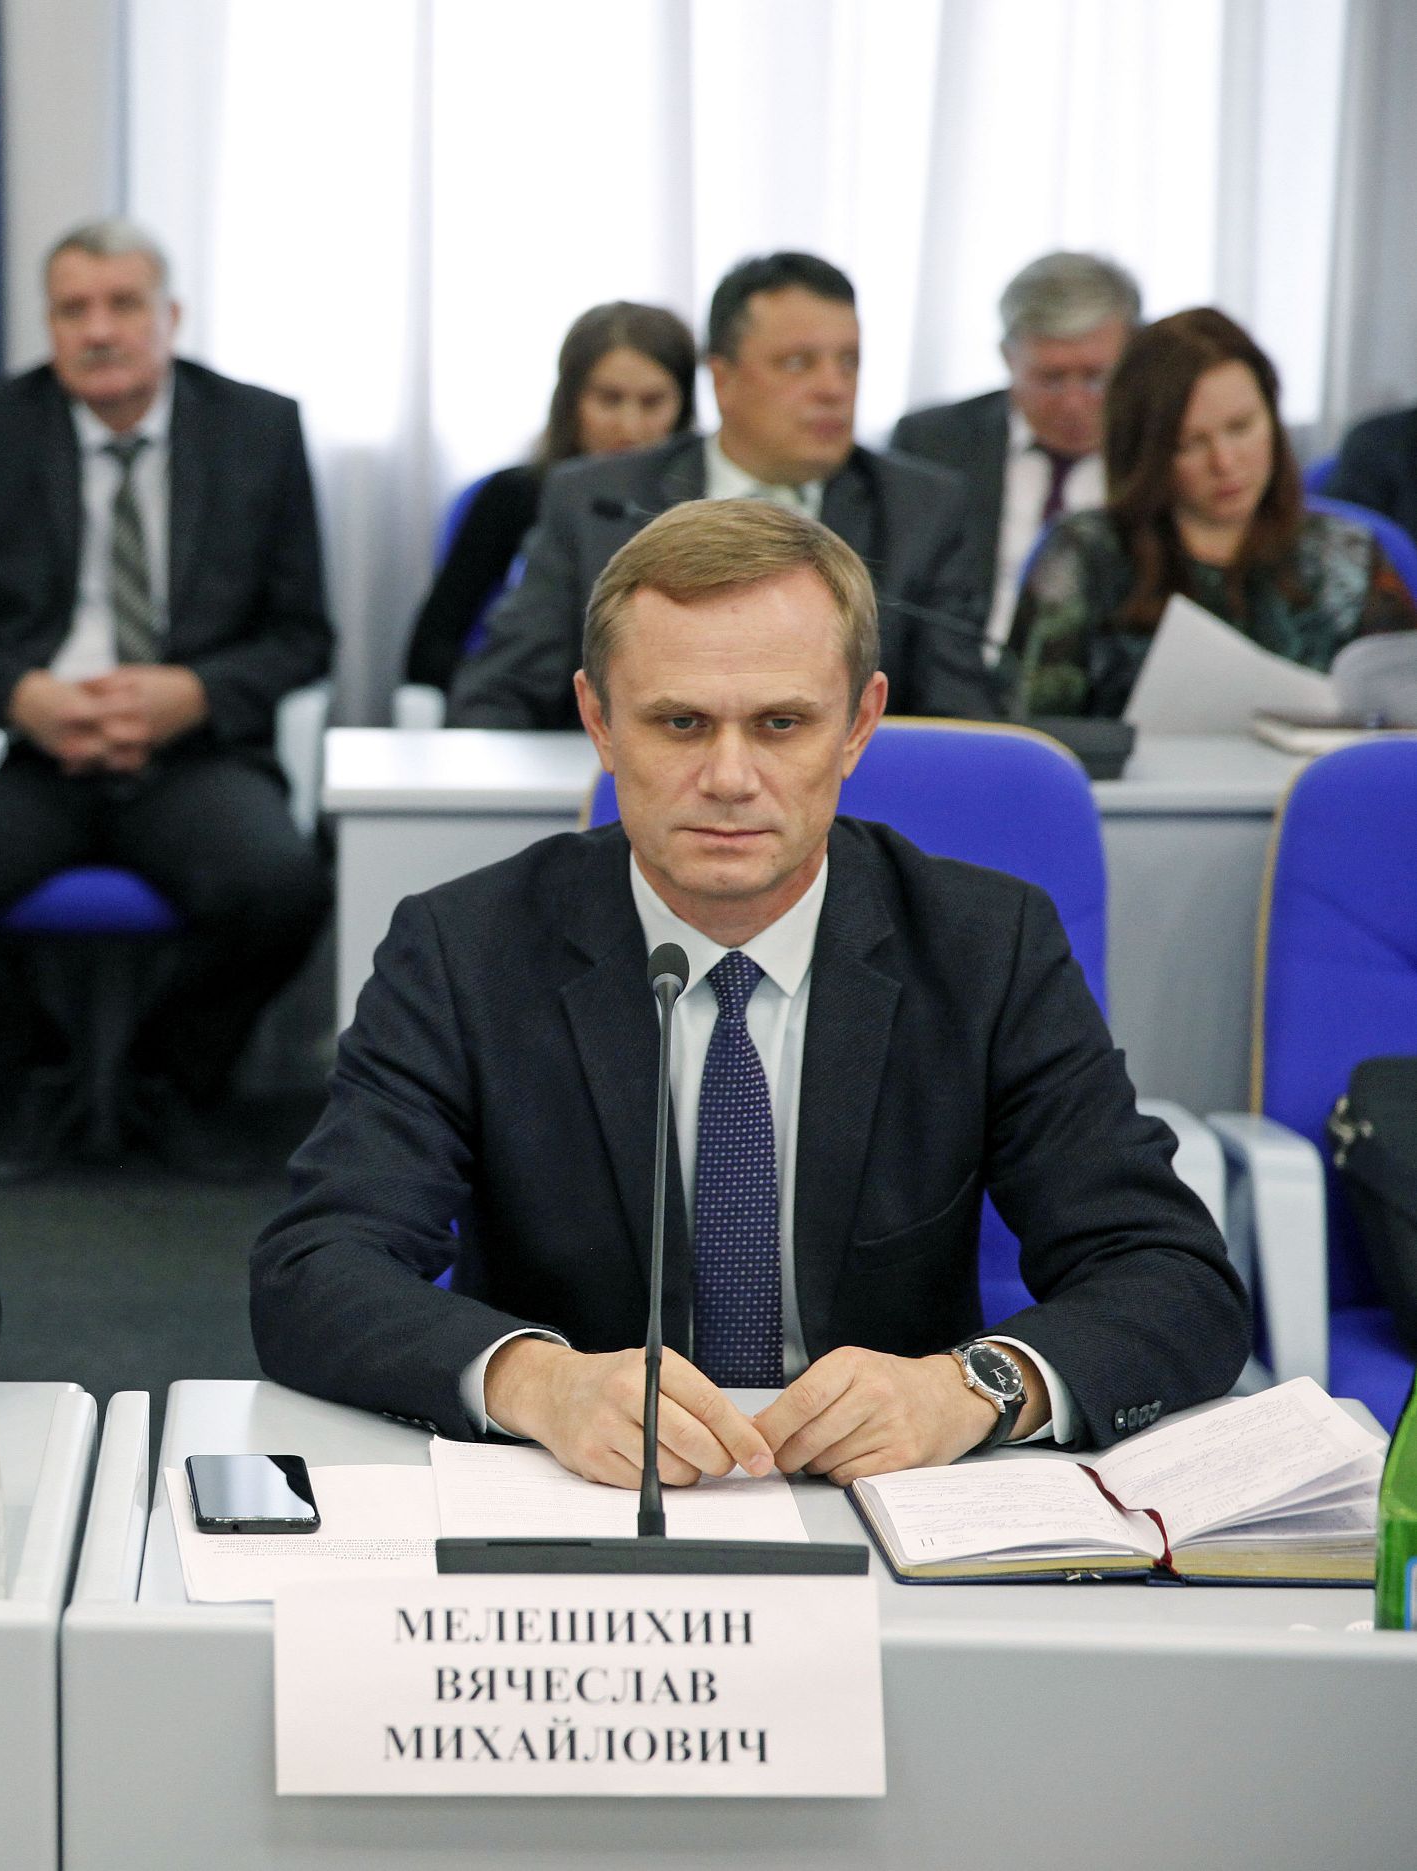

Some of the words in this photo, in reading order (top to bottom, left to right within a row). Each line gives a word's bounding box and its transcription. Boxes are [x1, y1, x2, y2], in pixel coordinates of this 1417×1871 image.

[395, 1609, 754, 1645] МЕЛЕШИХИН
[435, 1668, 719, 1704] ВЯЧЕСЛАВ
[383, 1718, 769, 1764] МИХАЙЛОВИЧ
